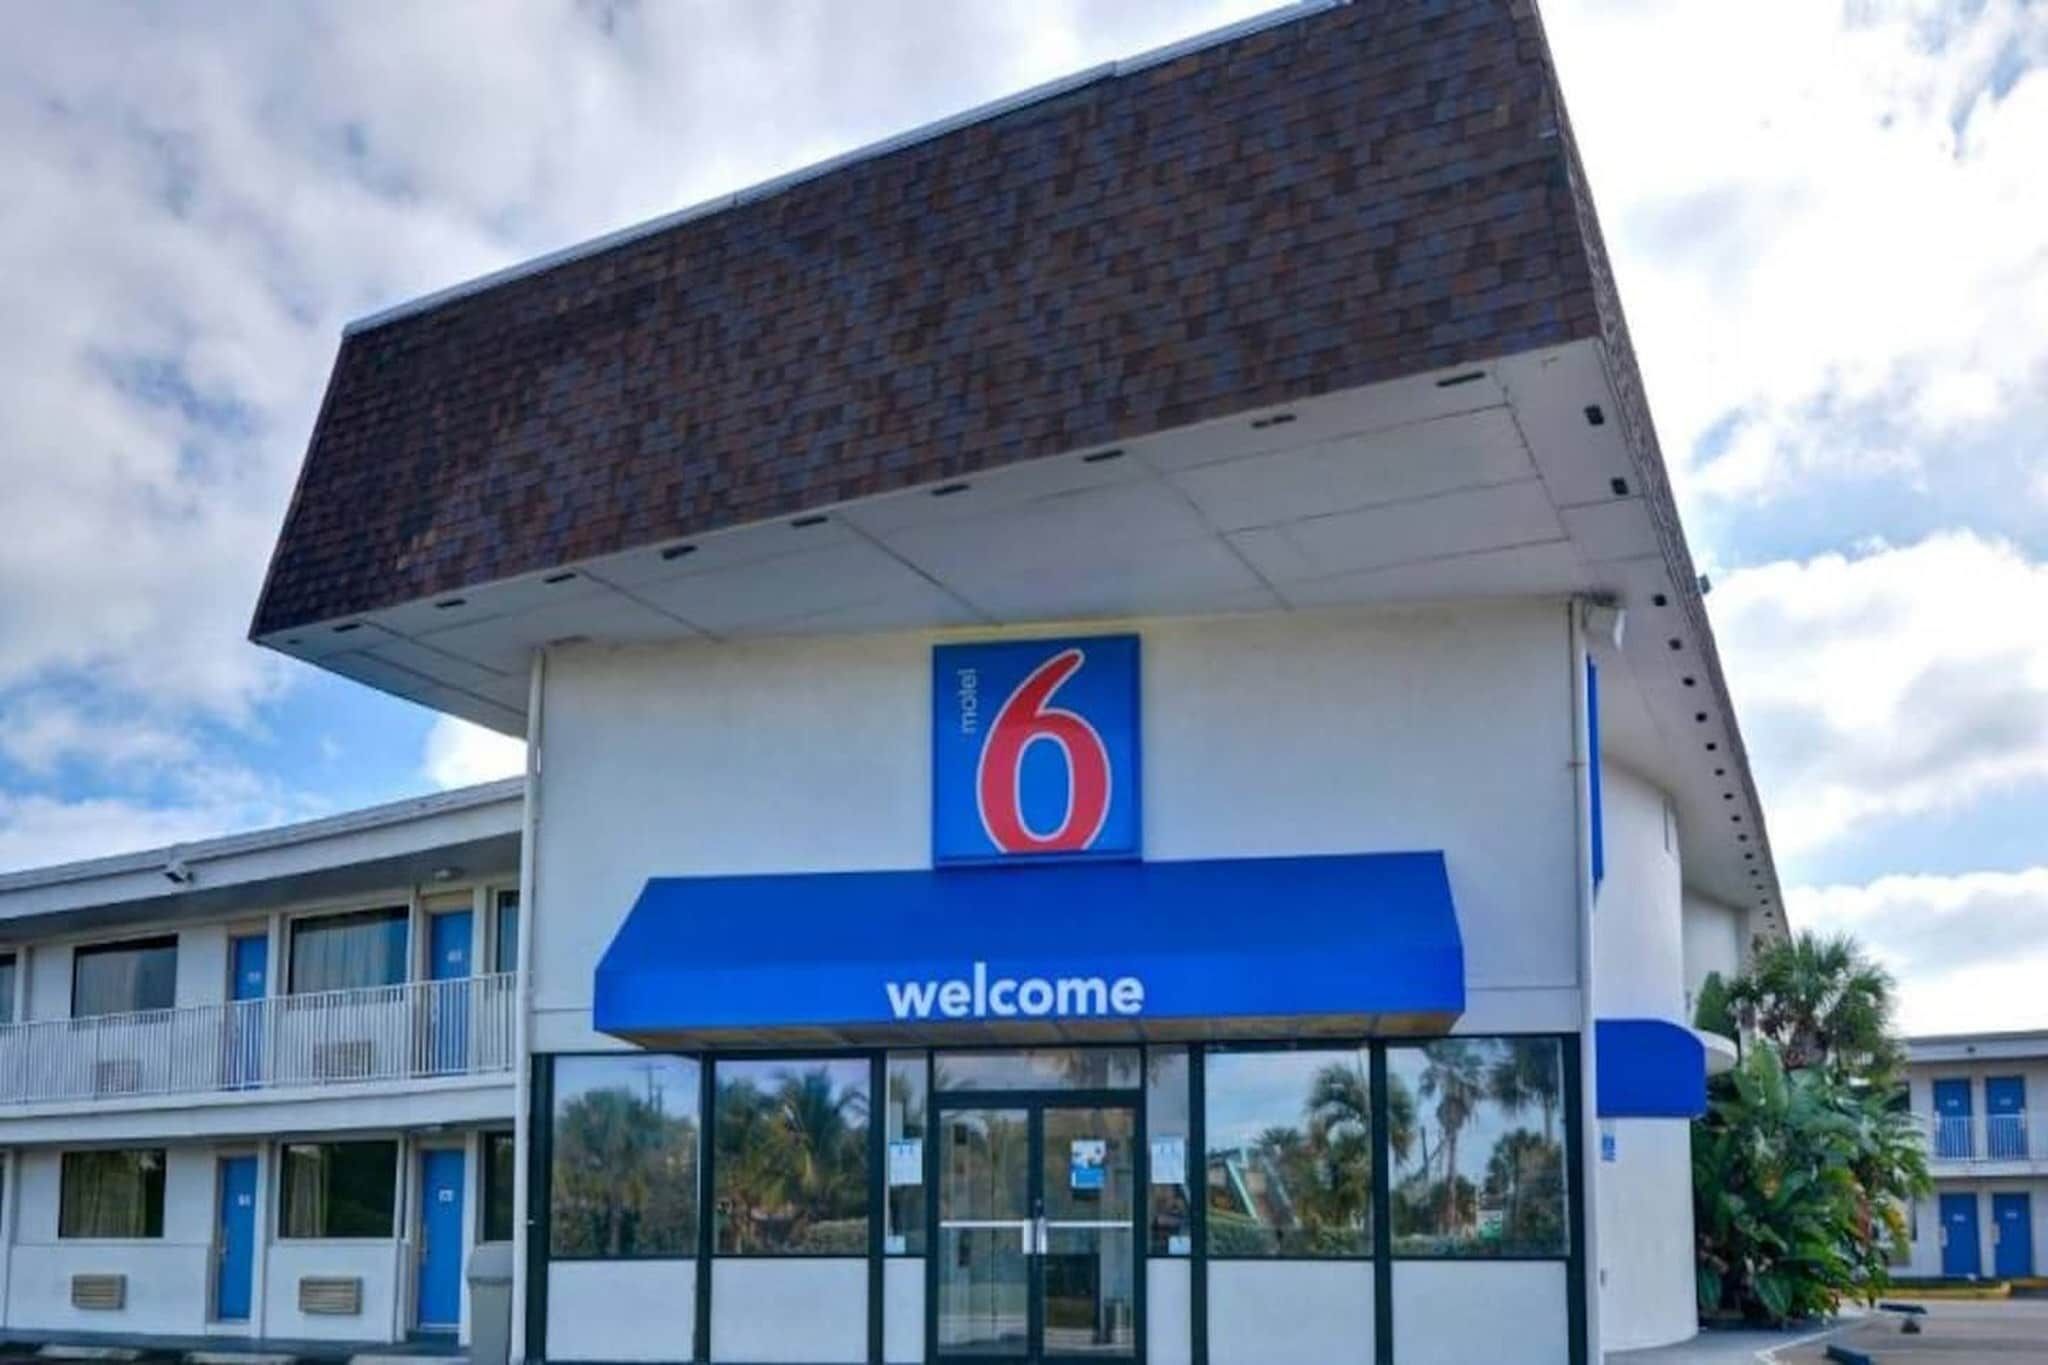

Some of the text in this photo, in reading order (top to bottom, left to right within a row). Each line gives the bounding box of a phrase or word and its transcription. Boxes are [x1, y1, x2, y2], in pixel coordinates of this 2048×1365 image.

[958, 668, 977, 734] motel
[977, 648, 1112, 854] 6
[886, 962, 1145, 1018] welcome
